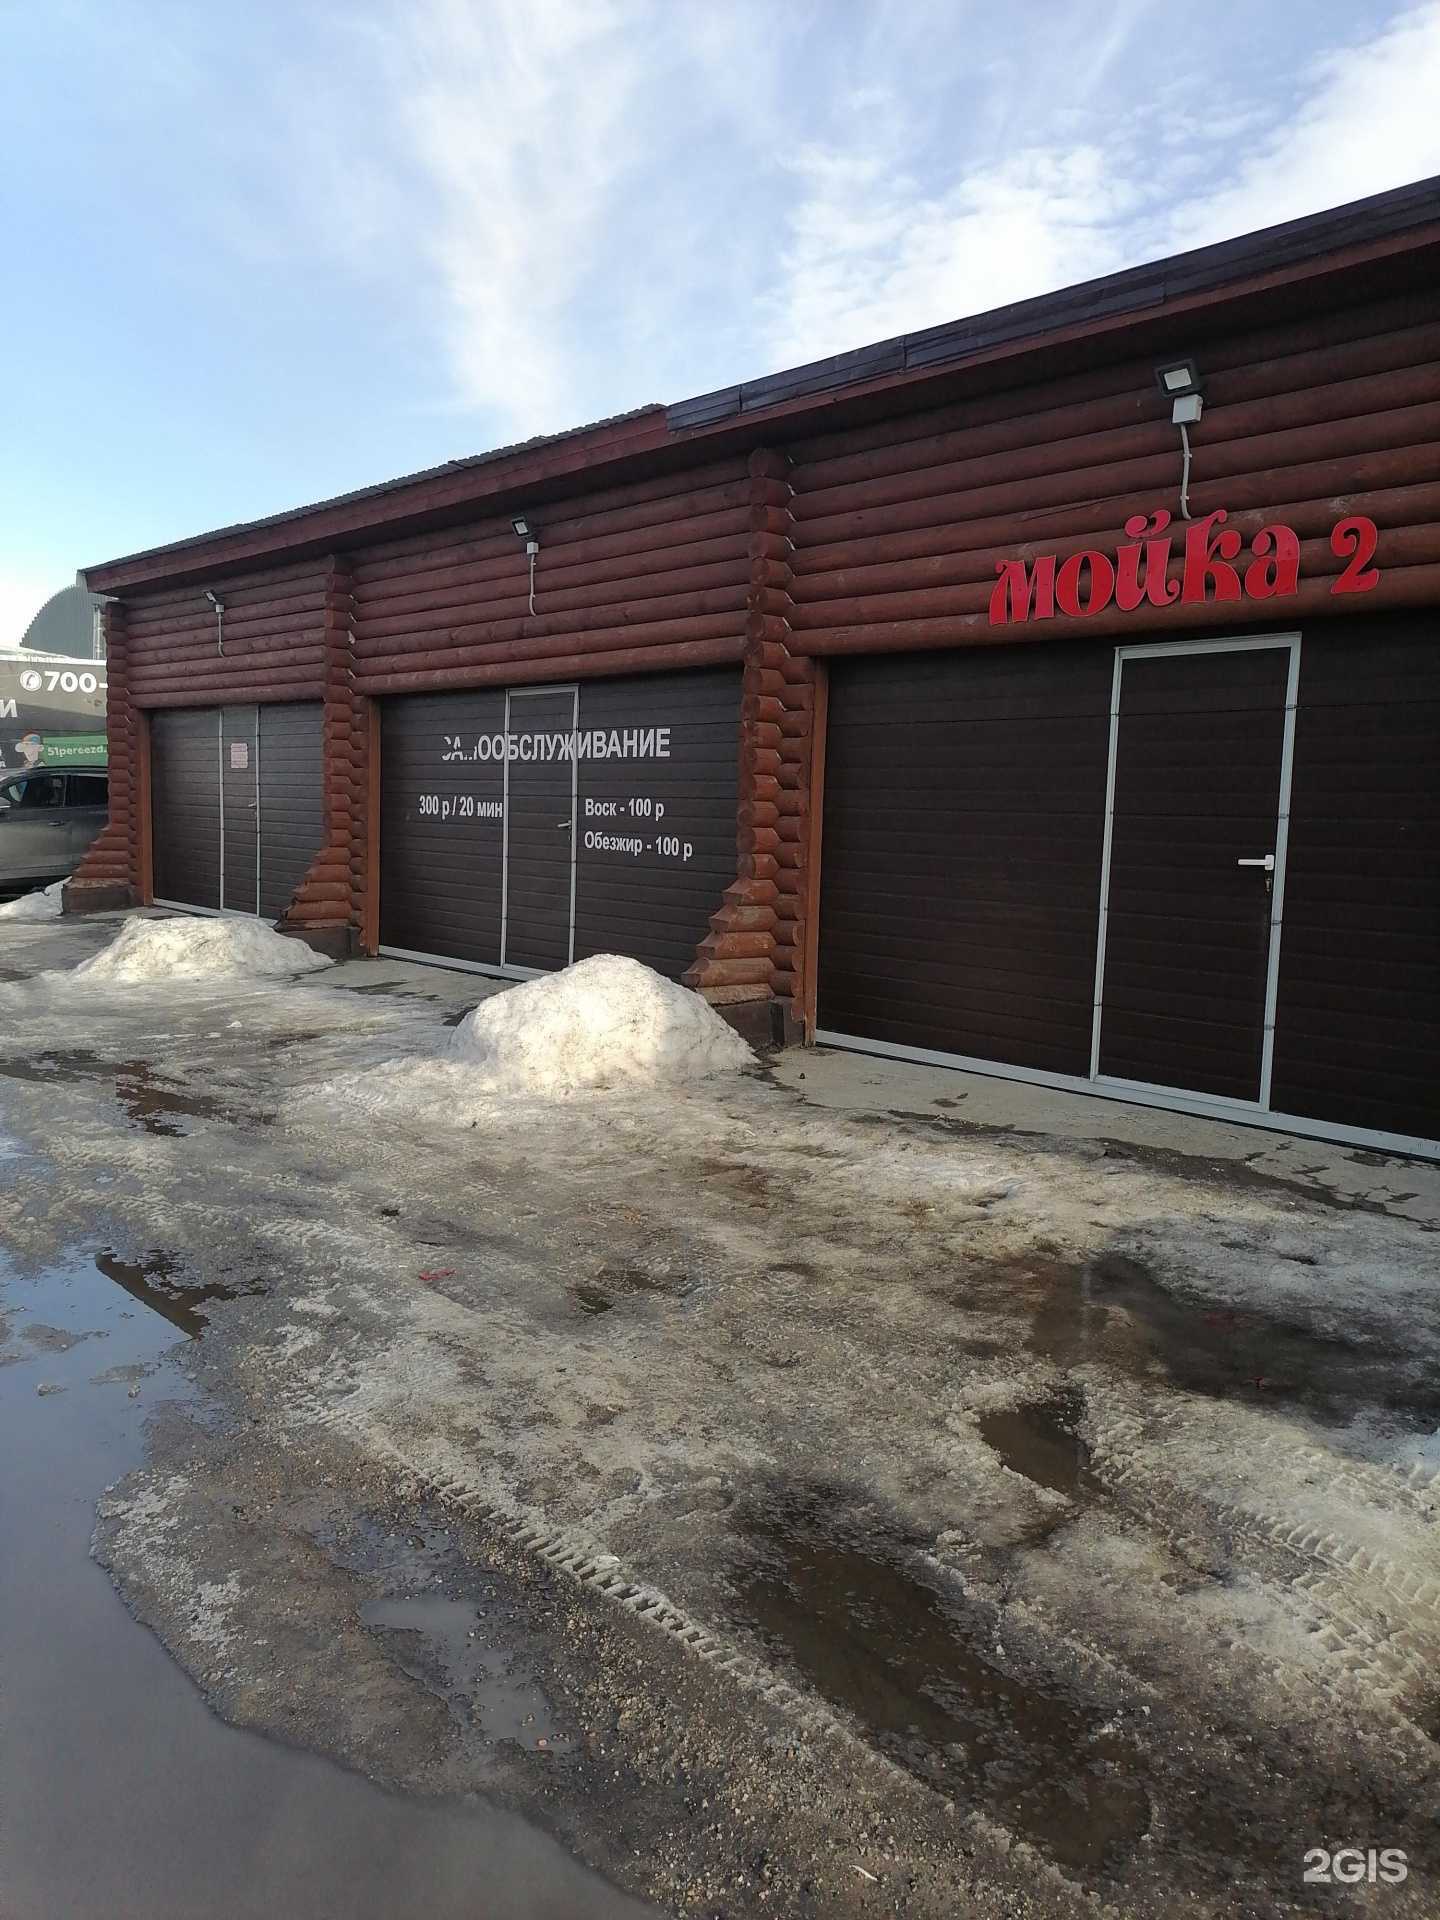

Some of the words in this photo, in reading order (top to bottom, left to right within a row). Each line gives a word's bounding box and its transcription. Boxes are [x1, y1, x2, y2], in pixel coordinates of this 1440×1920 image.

[1330, 516, 1381, 595] 2
[419, 795, 439, 815] 300
[458, 796, 474, 816] 20
[477, 801, 503, 818] мин
[585, 798, 617, 816] Воск
[628, 798, 652, 817] 100
[655, 802, 665, 822] р
[584, 831, 643, 857] Обезжир
[656, 836, 680, 856] 100
[683, 842, 693, 862] р
